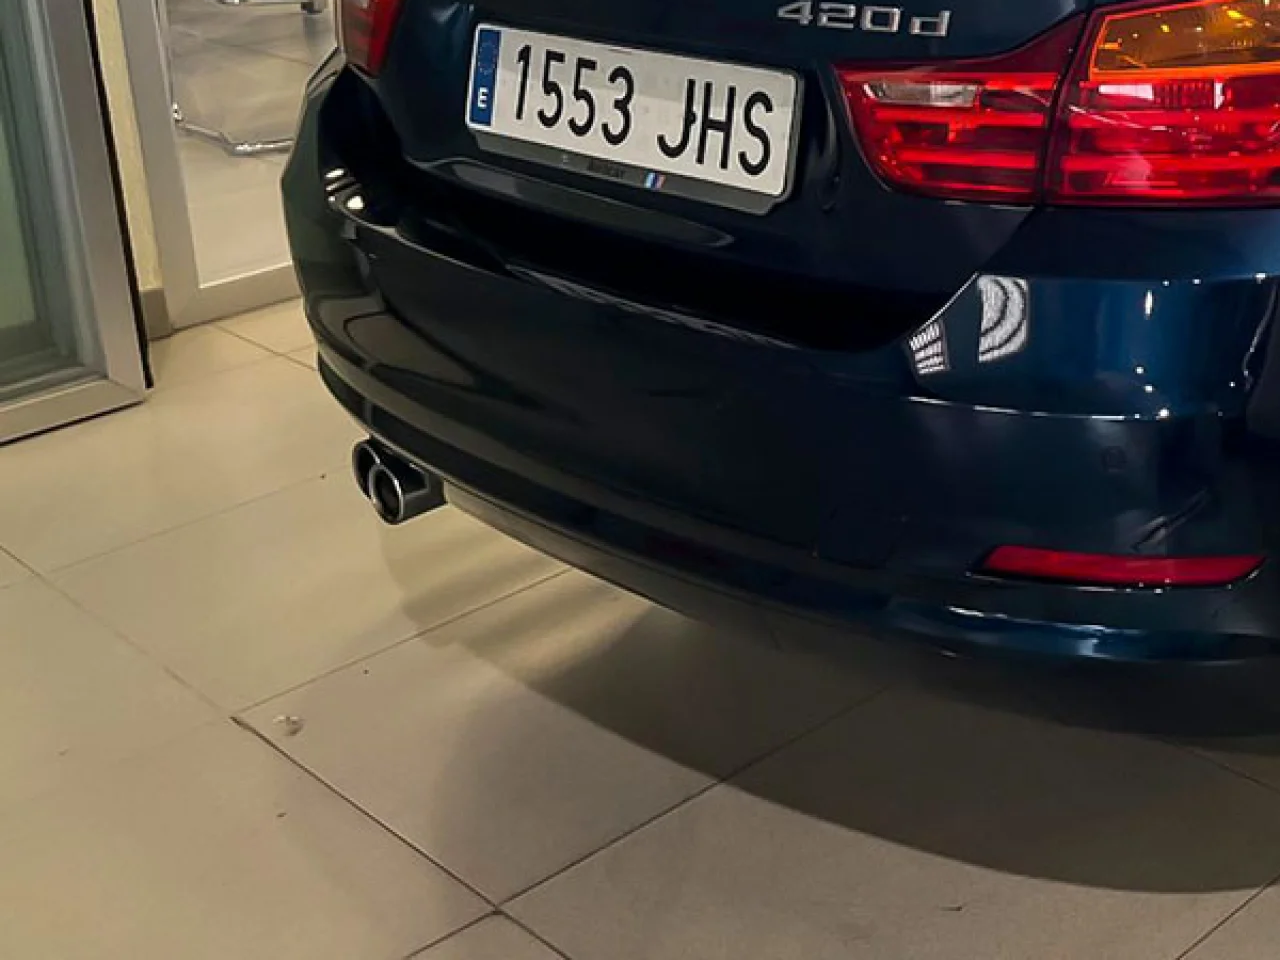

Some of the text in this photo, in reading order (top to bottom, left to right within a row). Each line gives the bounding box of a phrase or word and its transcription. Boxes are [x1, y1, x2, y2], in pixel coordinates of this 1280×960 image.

[776, 0, 952, 38] 420d
[476, 89, 488, 109] E
[513, 44, 775, 177] 1553 JHS
